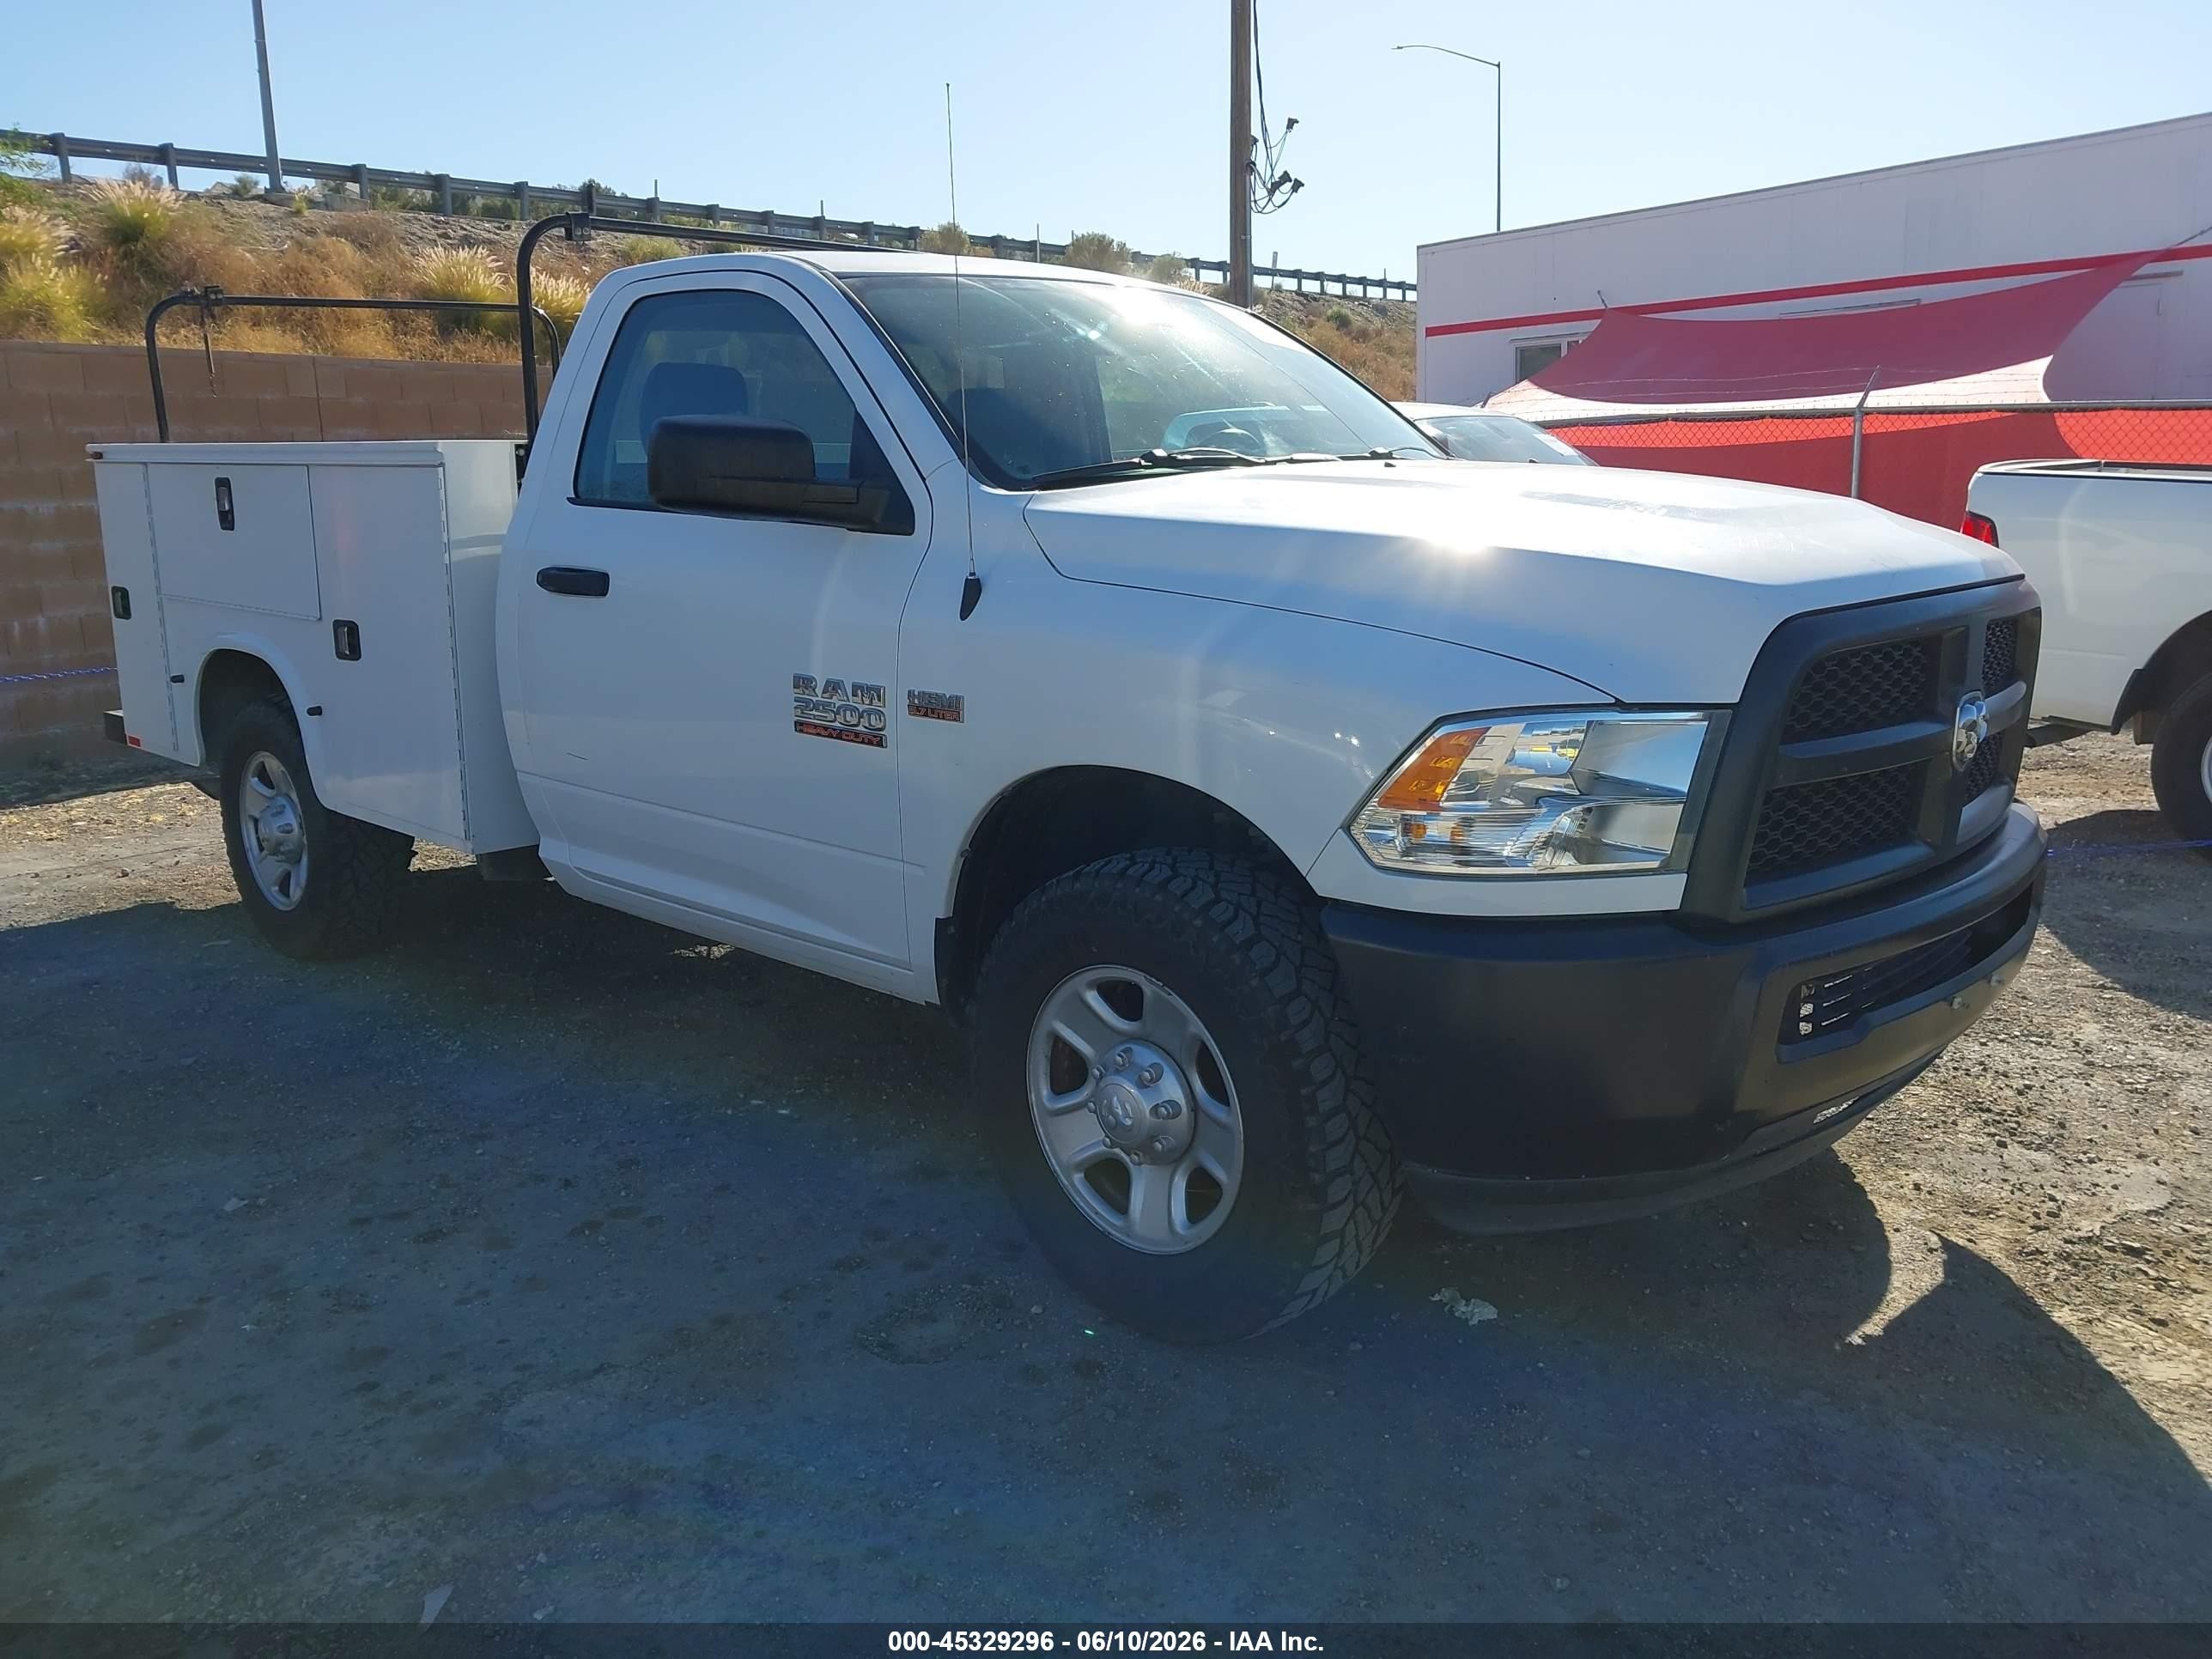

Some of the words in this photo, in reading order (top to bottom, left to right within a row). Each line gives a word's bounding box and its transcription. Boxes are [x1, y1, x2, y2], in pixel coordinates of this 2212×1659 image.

[793, 672, 886, 708] RAM
[907, 689, 964, 710] HEMI
[793, 696, 886, 732] 2500
[908, 705, 927, 716] 5.7
[927, 708, 960, 720] LITER
[796, 723, 839, 737] HEAVY
[842, 731, 881, 744] DUTY
